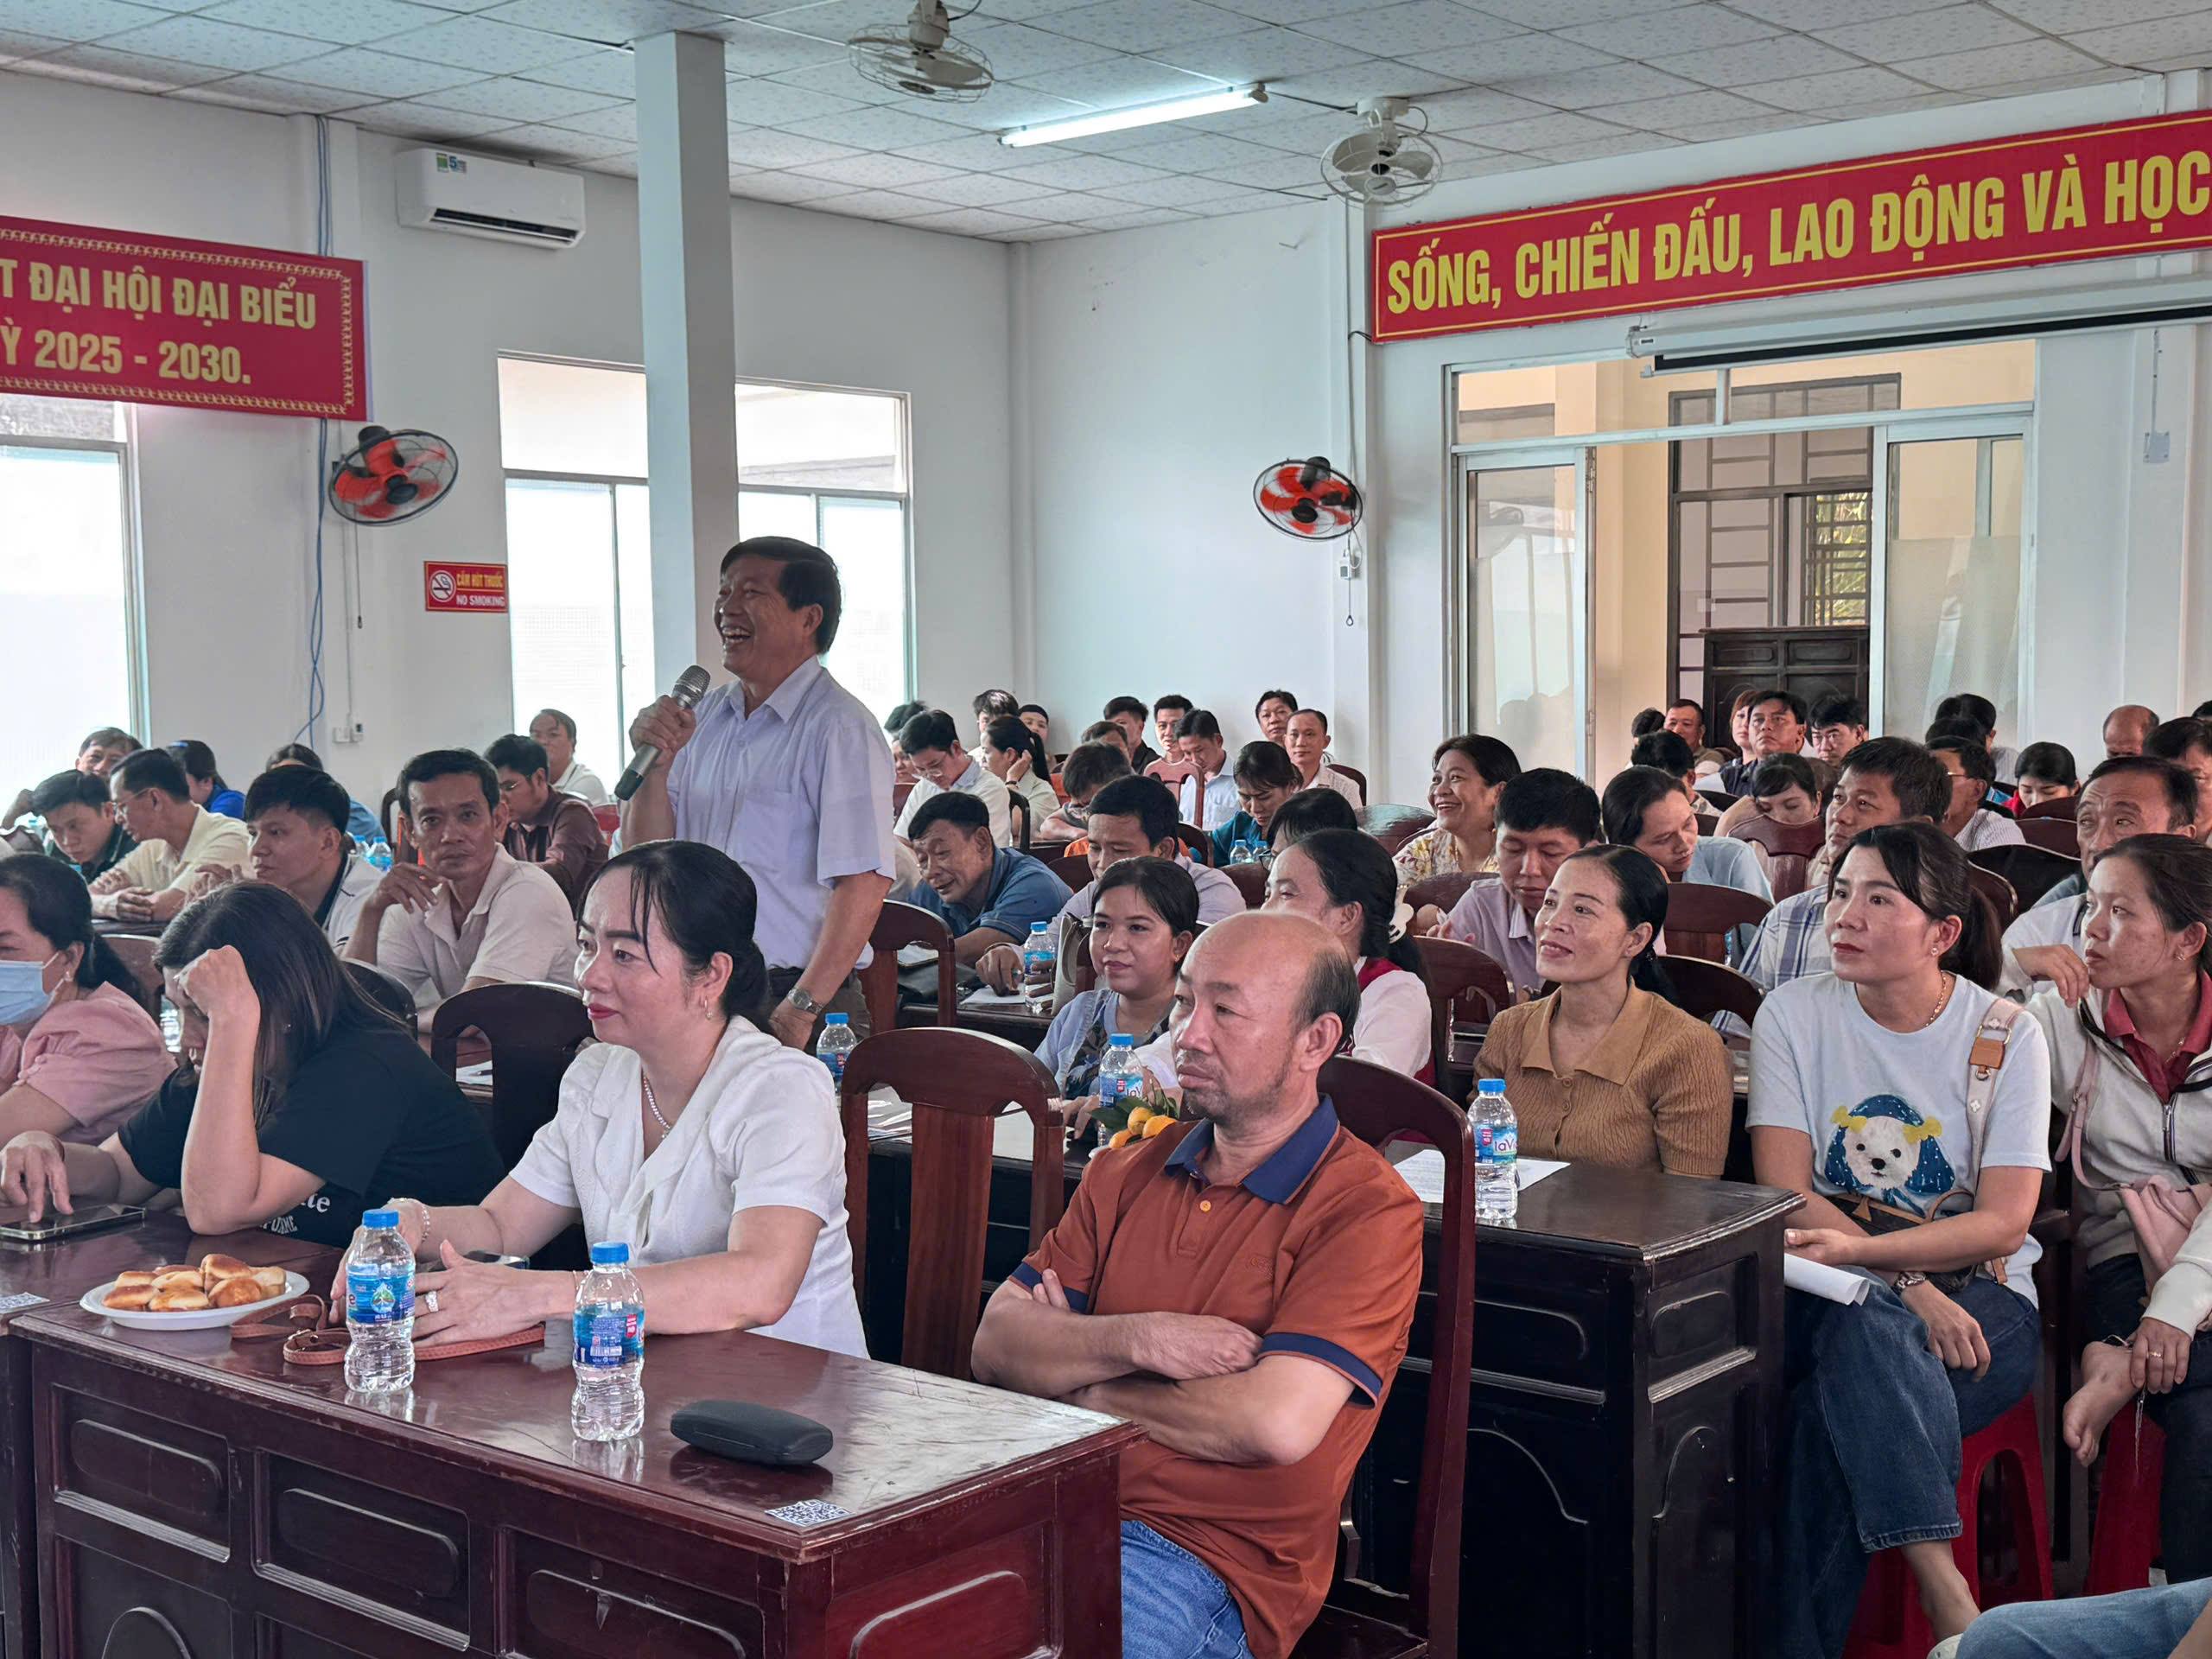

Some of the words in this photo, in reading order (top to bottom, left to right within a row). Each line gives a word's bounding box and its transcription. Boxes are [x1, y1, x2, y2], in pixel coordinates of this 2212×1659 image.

[1387, 238, 1501, 314] SỐNG,
[1516, 213, 1640, 299] CHIẾN
[1653, 198, 1752, 281] ĐẤU,
[1769, 198, 1854, 266] LAO
[1869, 174, 2005, 262] ĐỘNG
[2022, 155, 2087, 233] VÀ
[2104, 150, 2210, 234] HỌC
[29, 262, 91, 314] ĐẠI
[103, 265, 162, 321] HỘI
[172, 277, 229, 327] ĐẠI
[240, 276, 316, 330] BIỂU
[35, 329, 122, 374] 2025
[134, 354, 148, 365] -
[159, 340, 251, 385] 2030.
[456, 594, 467, 606] NO
[469, 594, 505, 607] SMOKING
